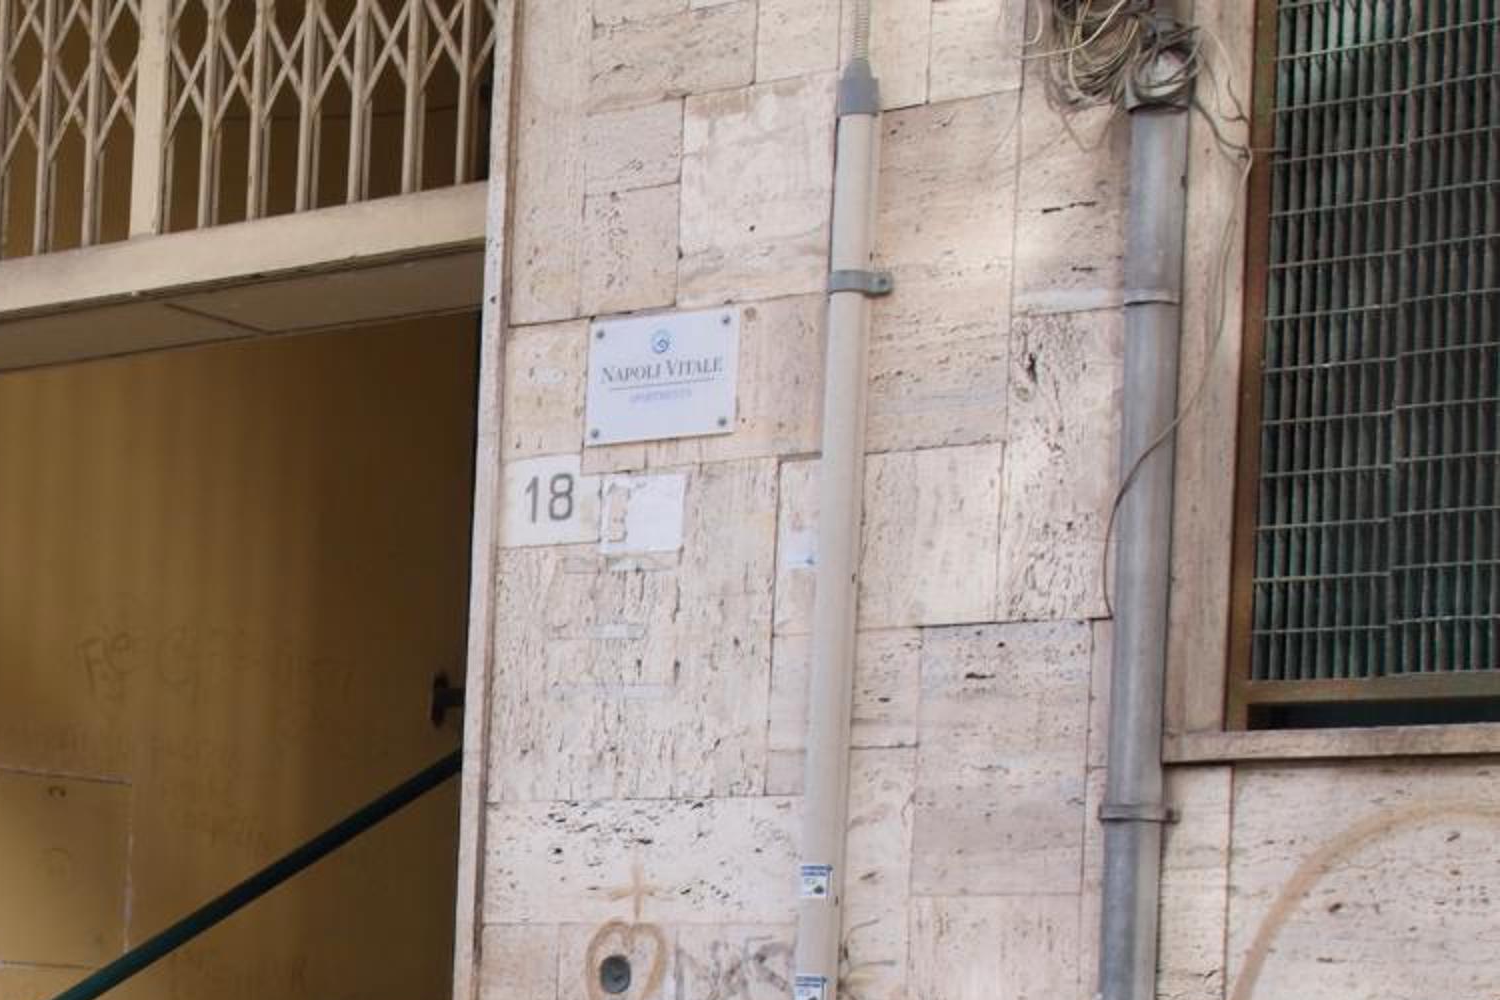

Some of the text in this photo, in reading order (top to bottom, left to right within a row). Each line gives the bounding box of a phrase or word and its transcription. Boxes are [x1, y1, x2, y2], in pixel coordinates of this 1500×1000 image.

[601, 356, 722, 384] NAPOLI VITALE
[524, 473, 575, 524] 18
